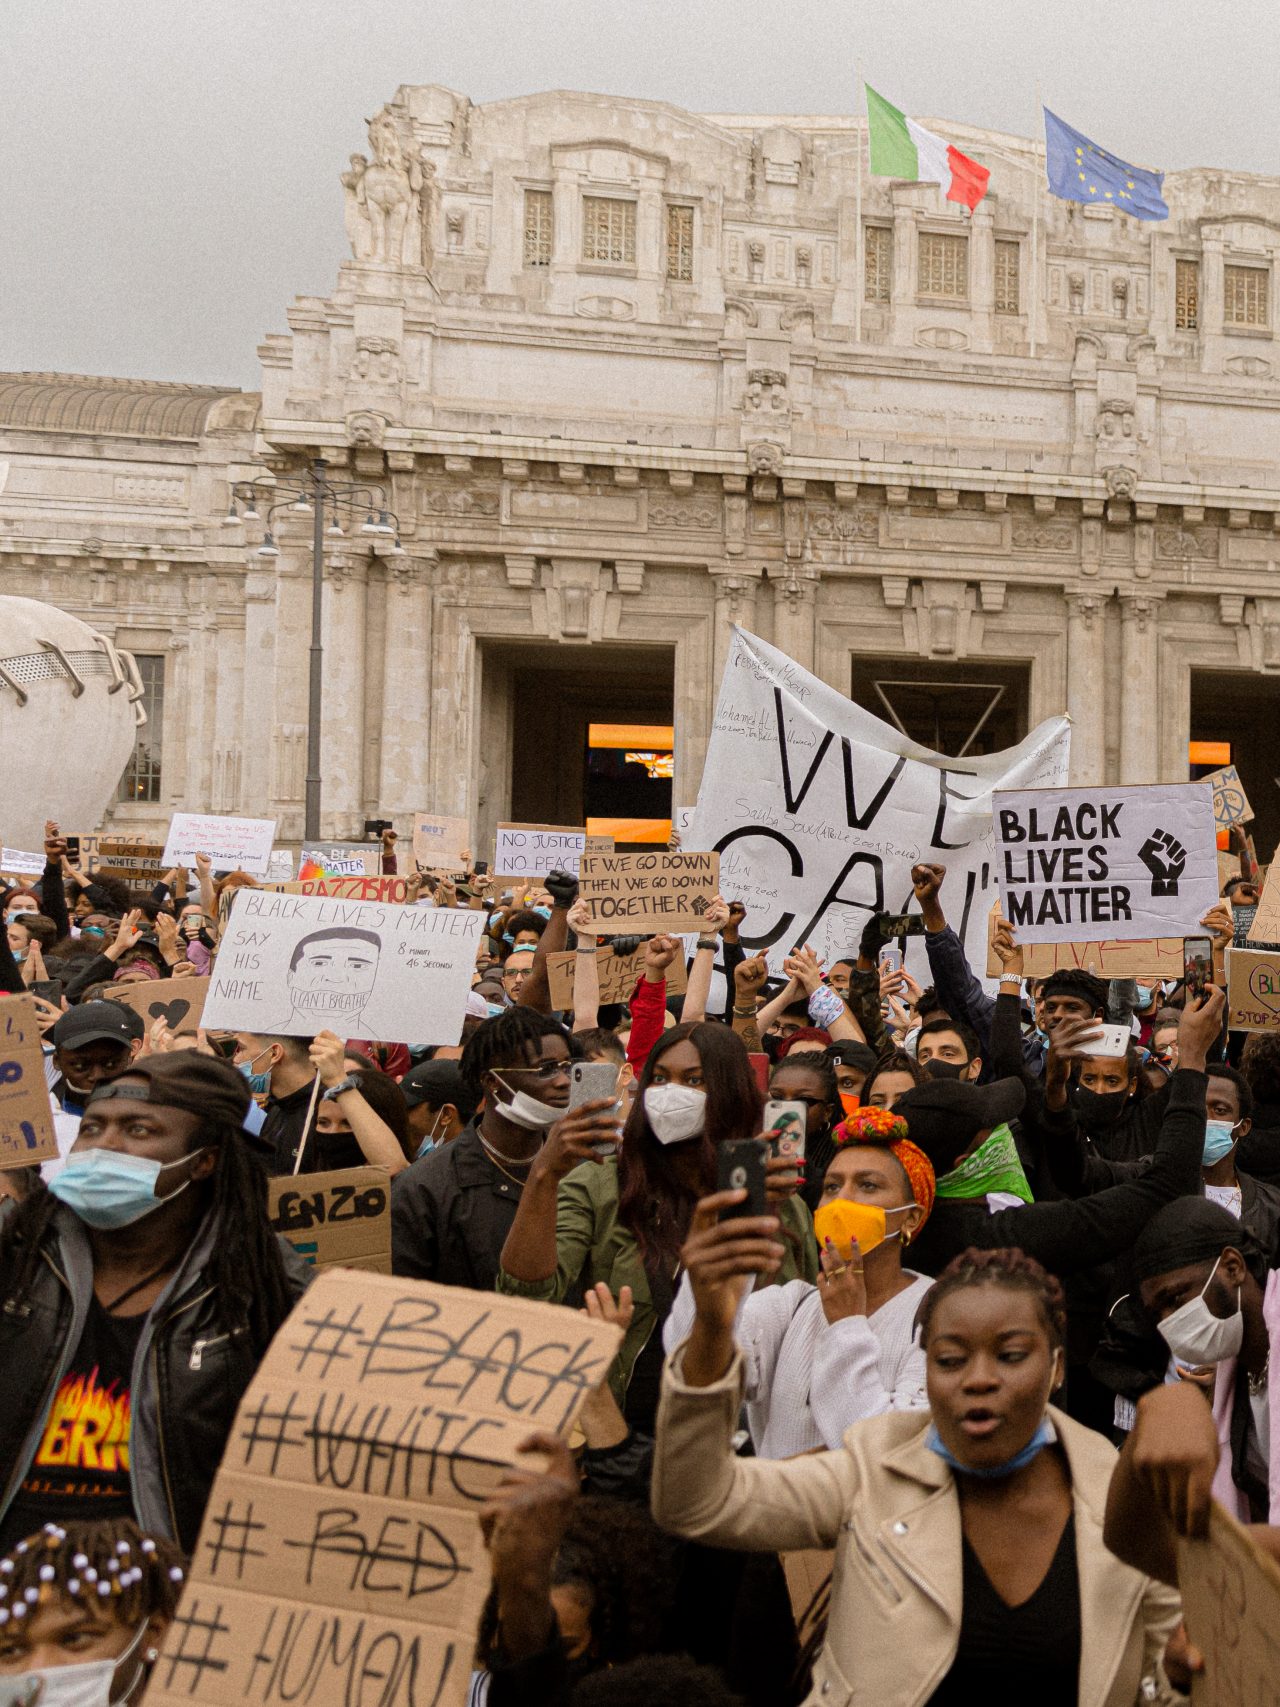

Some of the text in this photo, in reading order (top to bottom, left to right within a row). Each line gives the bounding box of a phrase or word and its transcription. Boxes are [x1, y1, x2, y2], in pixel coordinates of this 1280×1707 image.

[774, 687, 978, 850] WE
[999, 802, 1127, 844] BLACK
[502, 833, 528, 847] NO
[530, 833, 583, 851] JUSTICE
[106, 856, 138, 868] WHITE
[503, 856, 582, 873] NO PEACE
[583, 853, 712, 875] IF WE GO DOWN
[1004, 844, 1109, 886] LIVES
[580, 874, 715, 893] THEN WE GO DOWN
[586, 894, 689, 921] TOGETHER
[1006, 884, 1133, 928] MATTER
[245, 895, 309, 920] BLACK
[316, 902, 386, 929] LIVES
[395, 910, 480, 938] MATTER
[233, 929, 272, 947] SAY
[397, 941, 407, 955] 8
[233, 953, 261, 970] HIS
[406, 958, 420, 968] 46
[214, 979, 265, 1001] NAME
[1235, 1010, 1269, 1027] STOP
